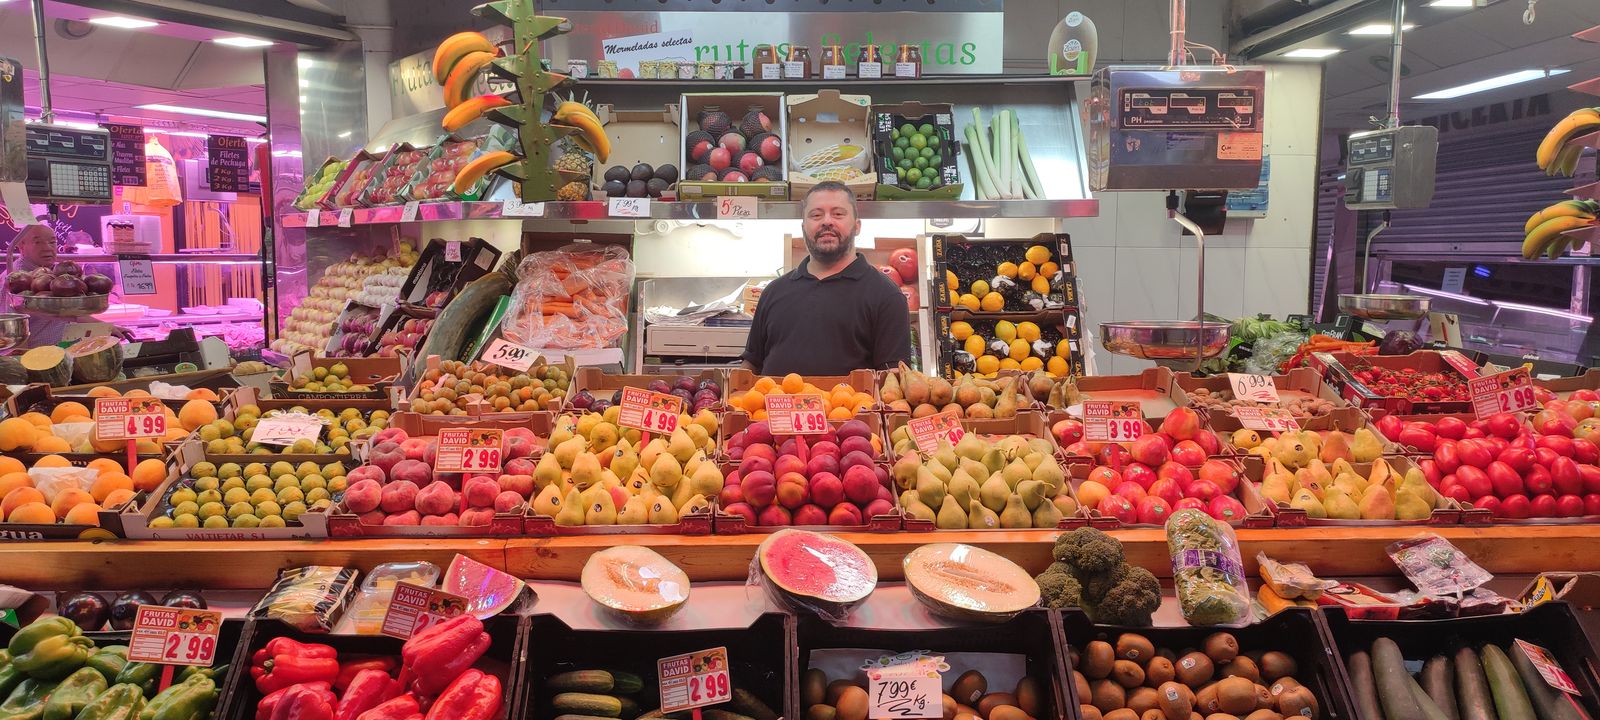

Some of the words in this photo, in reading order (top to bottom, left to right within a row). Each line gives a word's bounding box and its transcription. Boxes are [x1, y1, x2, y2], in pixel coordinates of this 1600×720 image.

[605, 42, 658, 54] Mermeladas
[661, 37, 693, 48] selectas
[218, 137, 247, 148] Oferta
[219, 151, 240, 159] Filetes
[220, 159, 246, 168] Pechuga
[1474, 378, 1497, 388] FRUTAS
[627, 390, 650, 398] FRUTAS
[1475, 384, 1498, 394] DAVID
[626, 395, 649, 404] DAVID
[914, 425, 934, 434] DAVID
[400, 586, 428, 599] FRUTAS
[397, 593, 426, 607] DAVID
[144, 611, 176, 619] FRUTAS
[142, 617, 174, 627] DAVID
[663, 658, 689, 669] FRUTAS
[663, 665, 689, 677] DAVID
